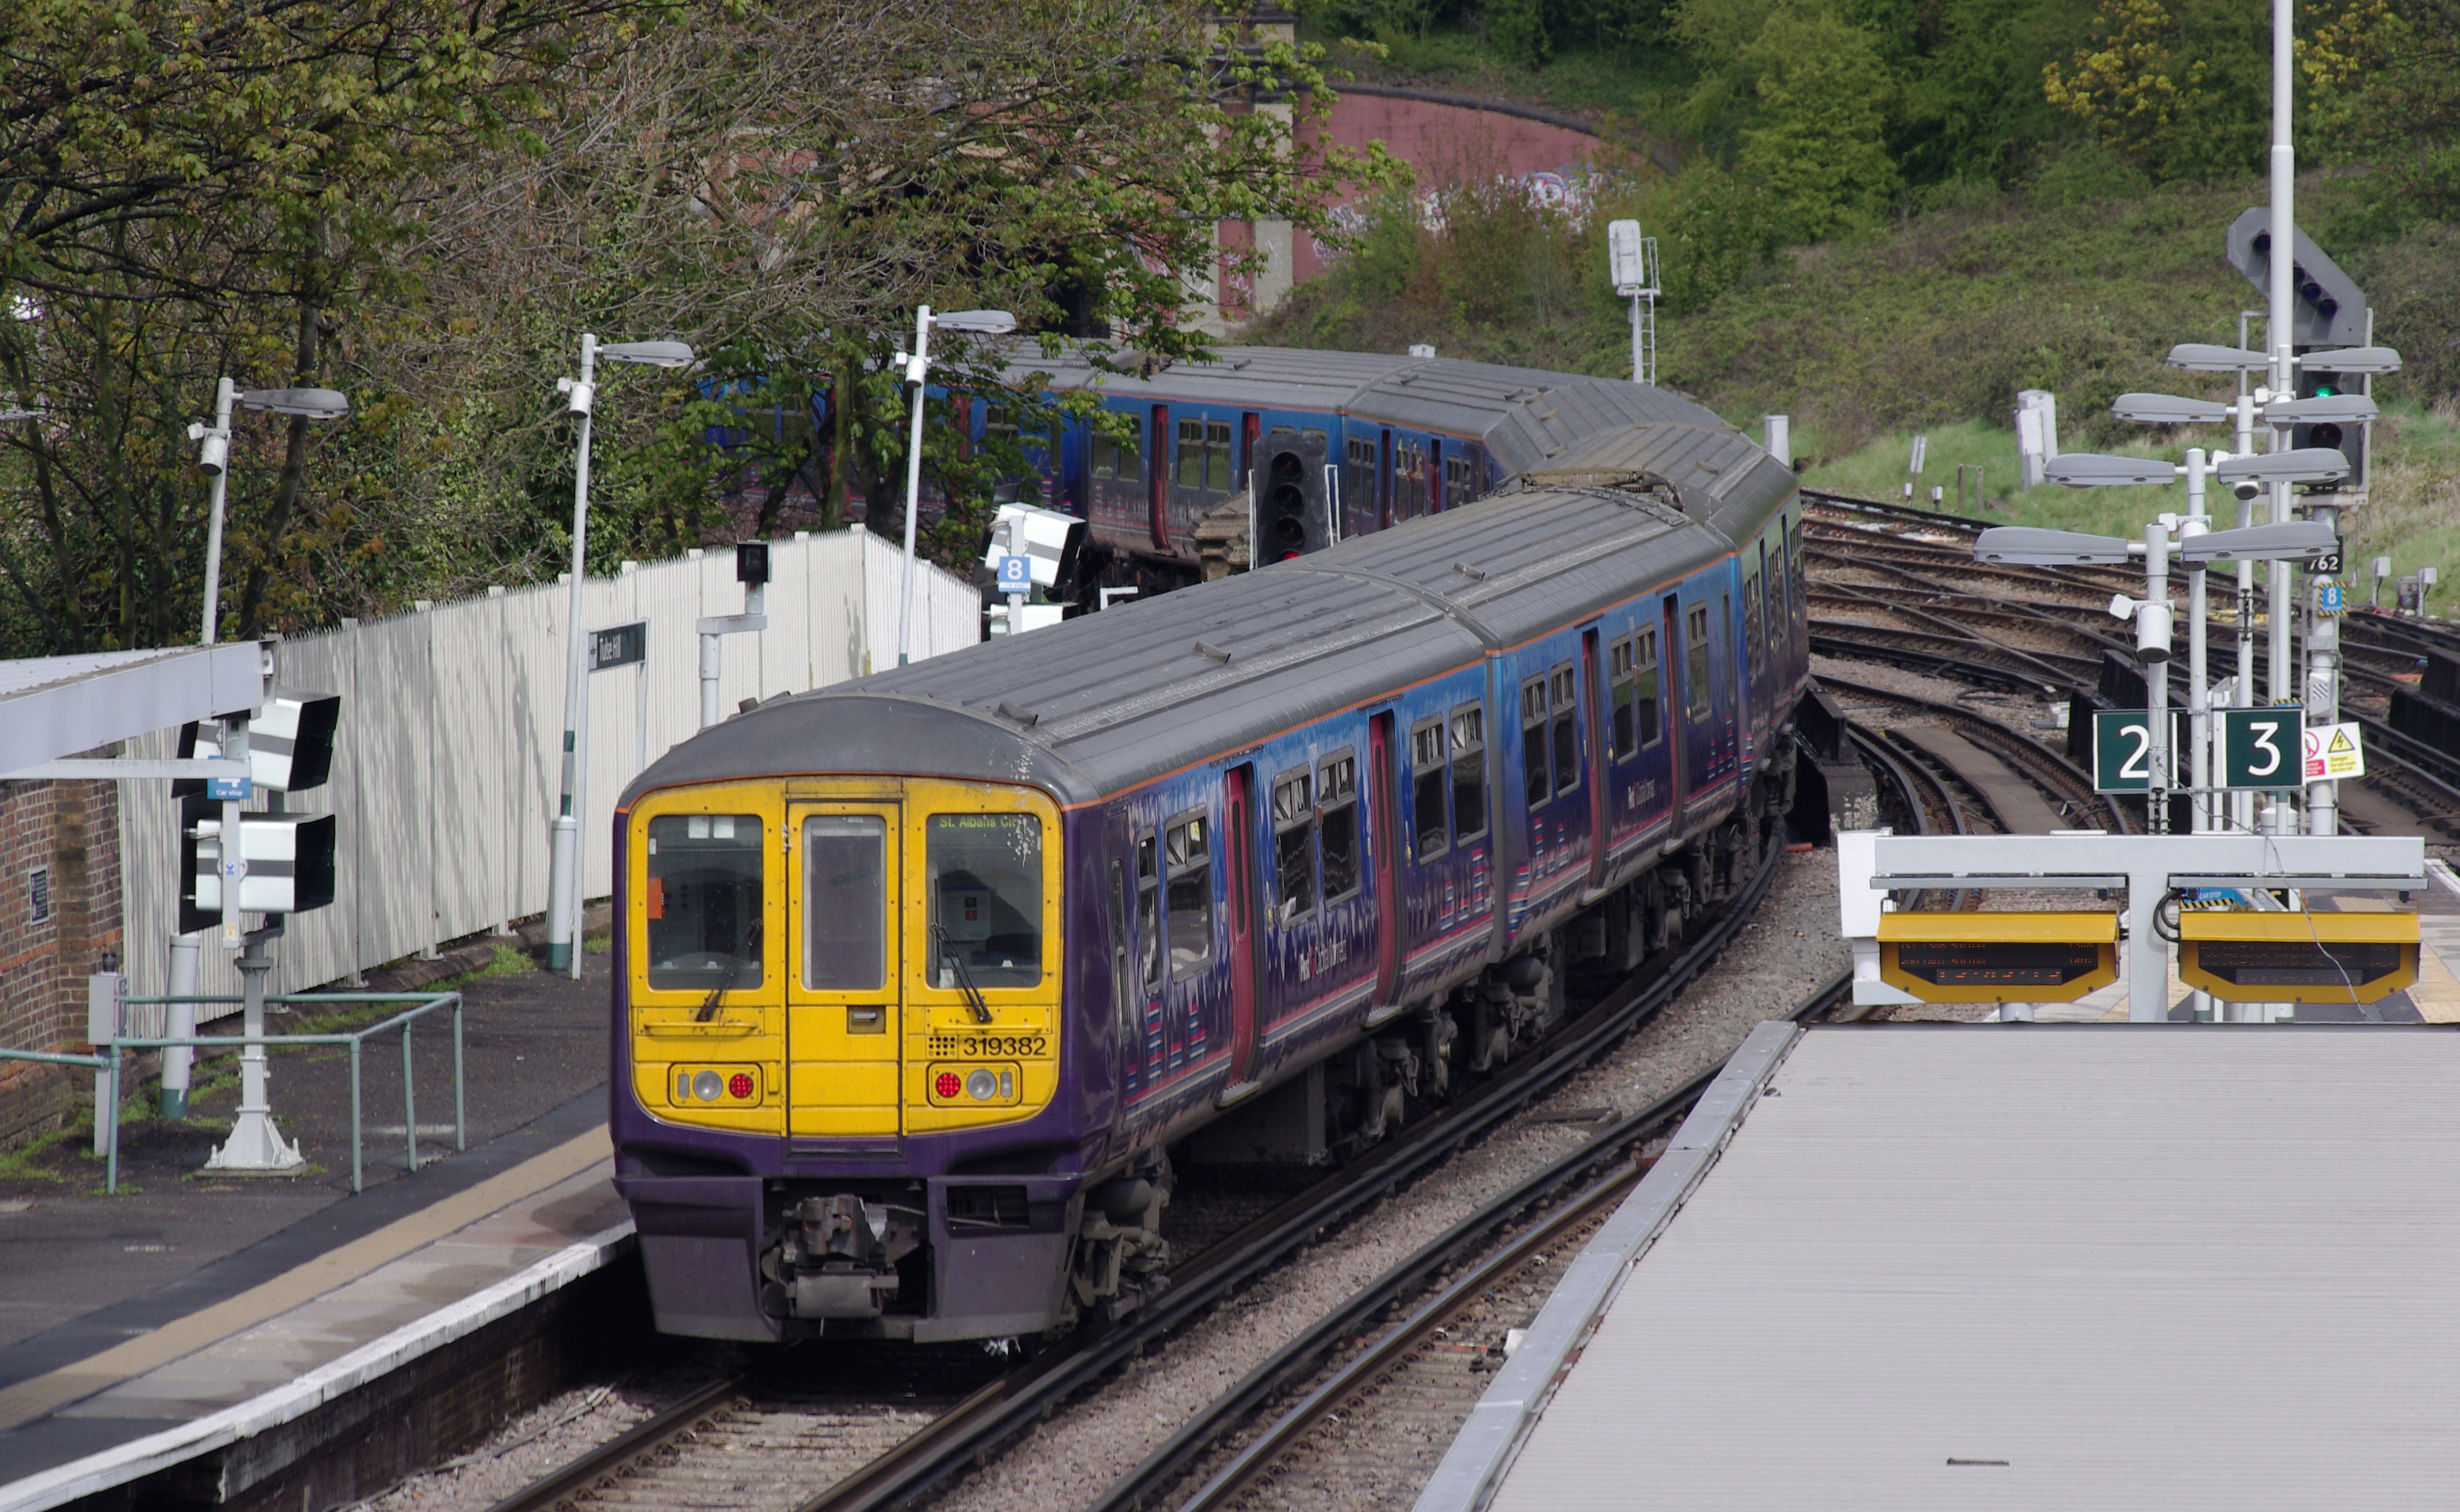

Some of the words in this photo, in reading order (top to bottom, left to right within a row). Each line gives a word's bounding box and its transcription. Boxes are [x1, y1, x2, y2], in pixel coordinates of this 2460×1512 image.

[1007, 559, 1023, 580] 8
[2328, 587, 2338, 604] 8
[2119, 724, 2150, 778] 2
[2247, 721, 2282, 777] 3
[228, 789, 243, 797] stop
[939, 815, 955, 828] St.
[959, 815, 997, 828] Albans
[963, 1037, 1047, 1056] 319382
